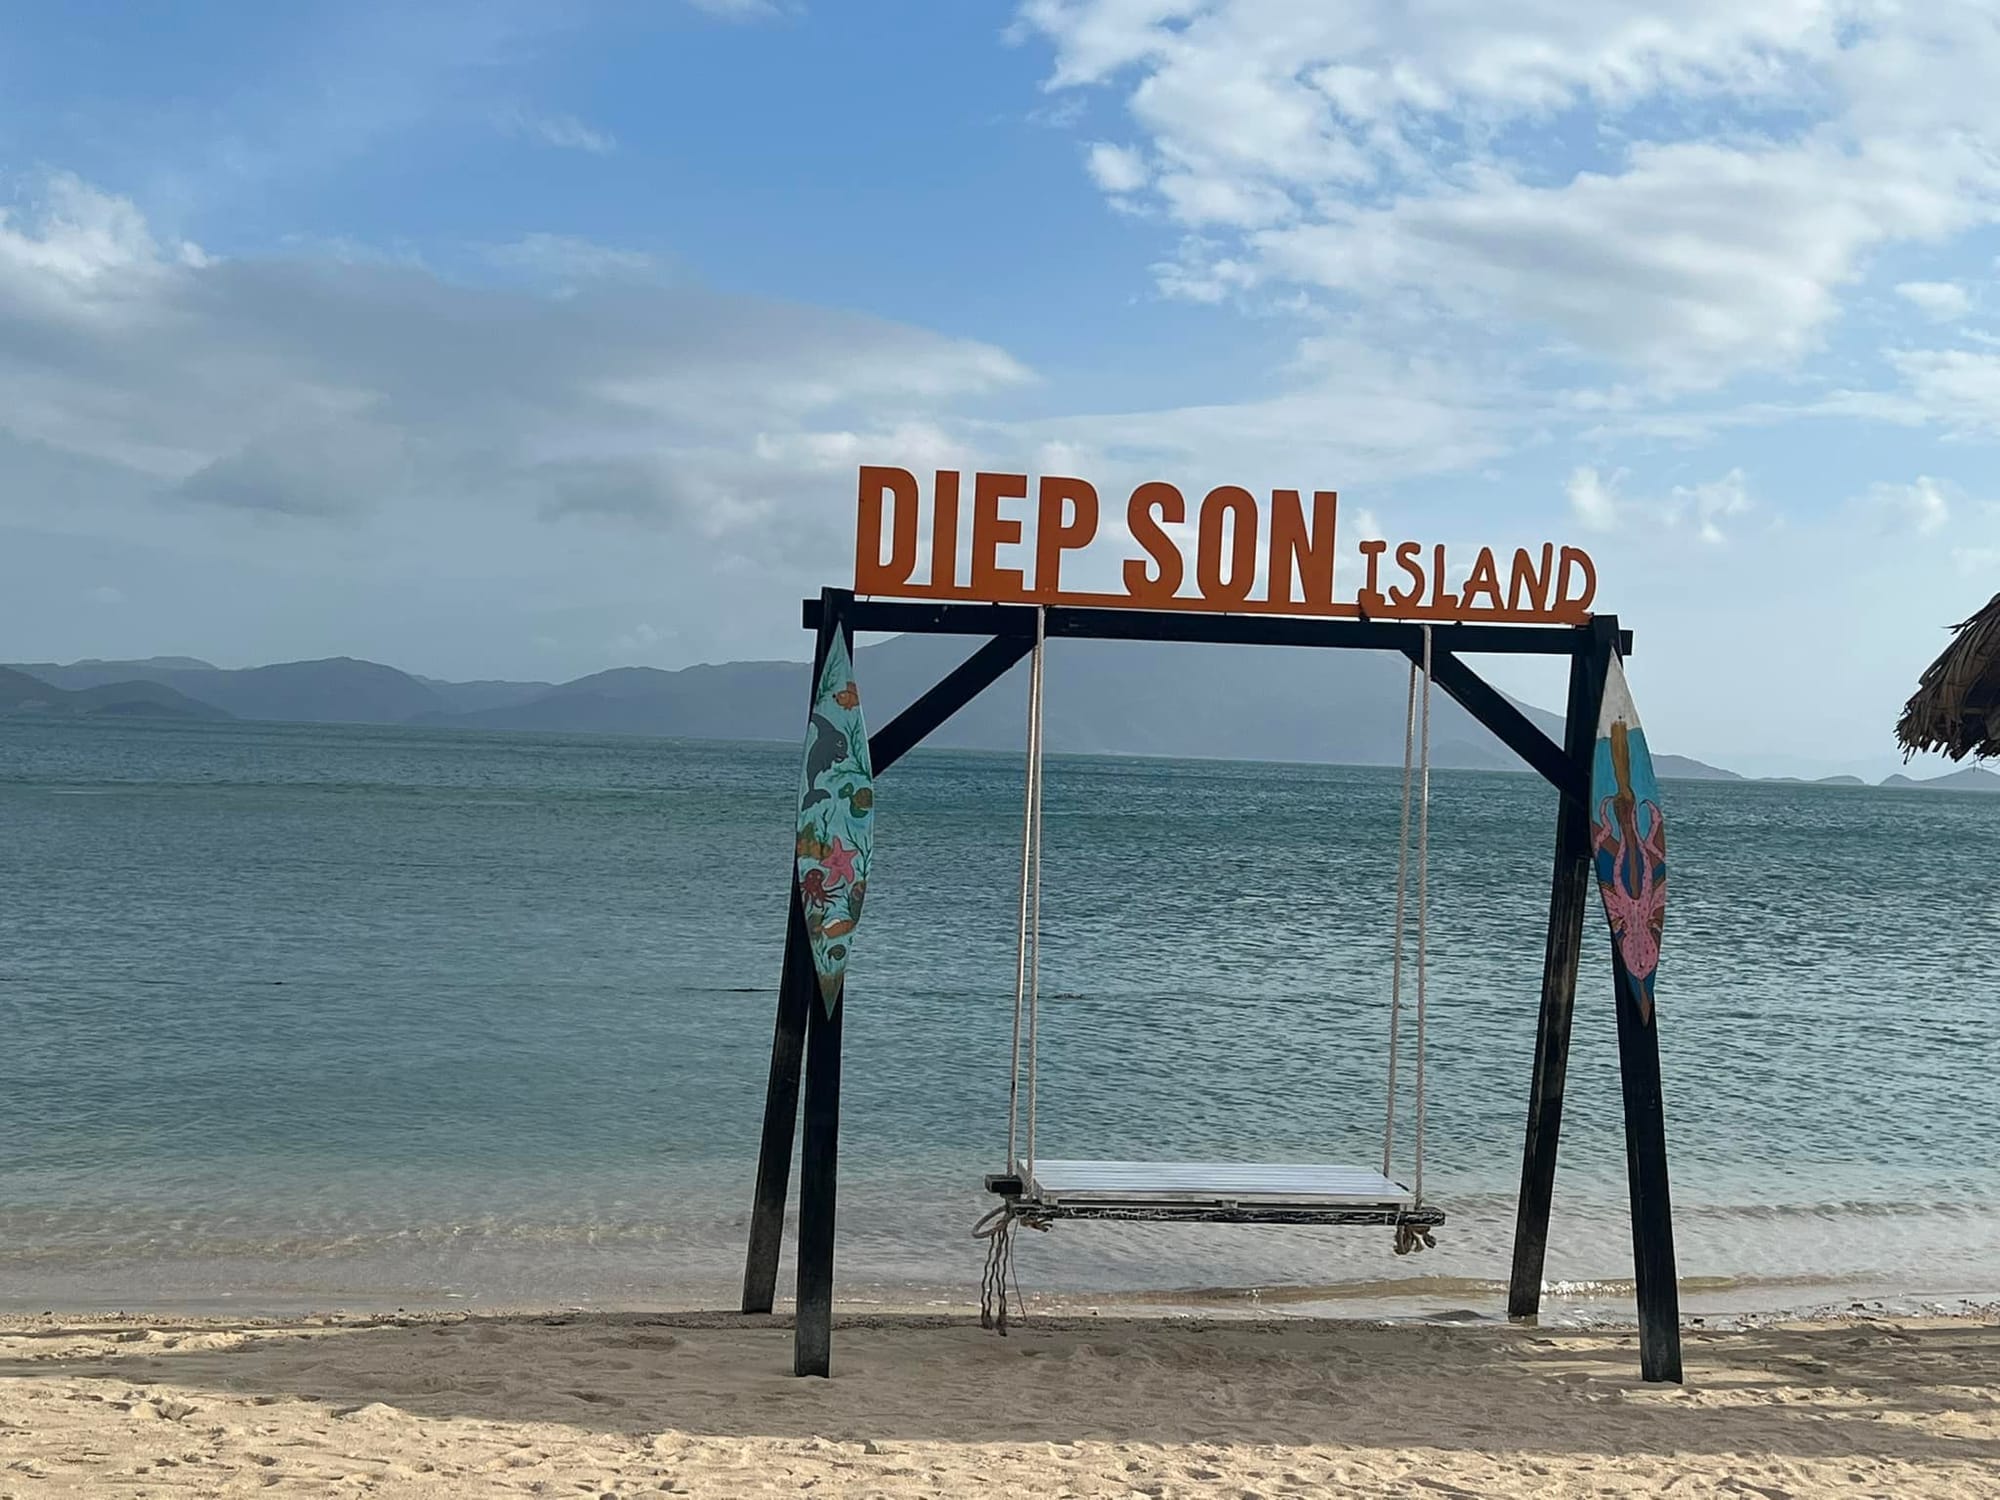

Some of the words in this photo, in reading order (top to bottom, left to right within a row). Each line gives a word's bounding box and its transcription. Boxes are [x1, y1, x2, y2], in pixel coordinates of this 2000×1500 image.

[856, 466, 1100, 596] DIEP
[1122, 482, 1338, 608] SON
[1358, 541, 1597, 616] ISLAND
